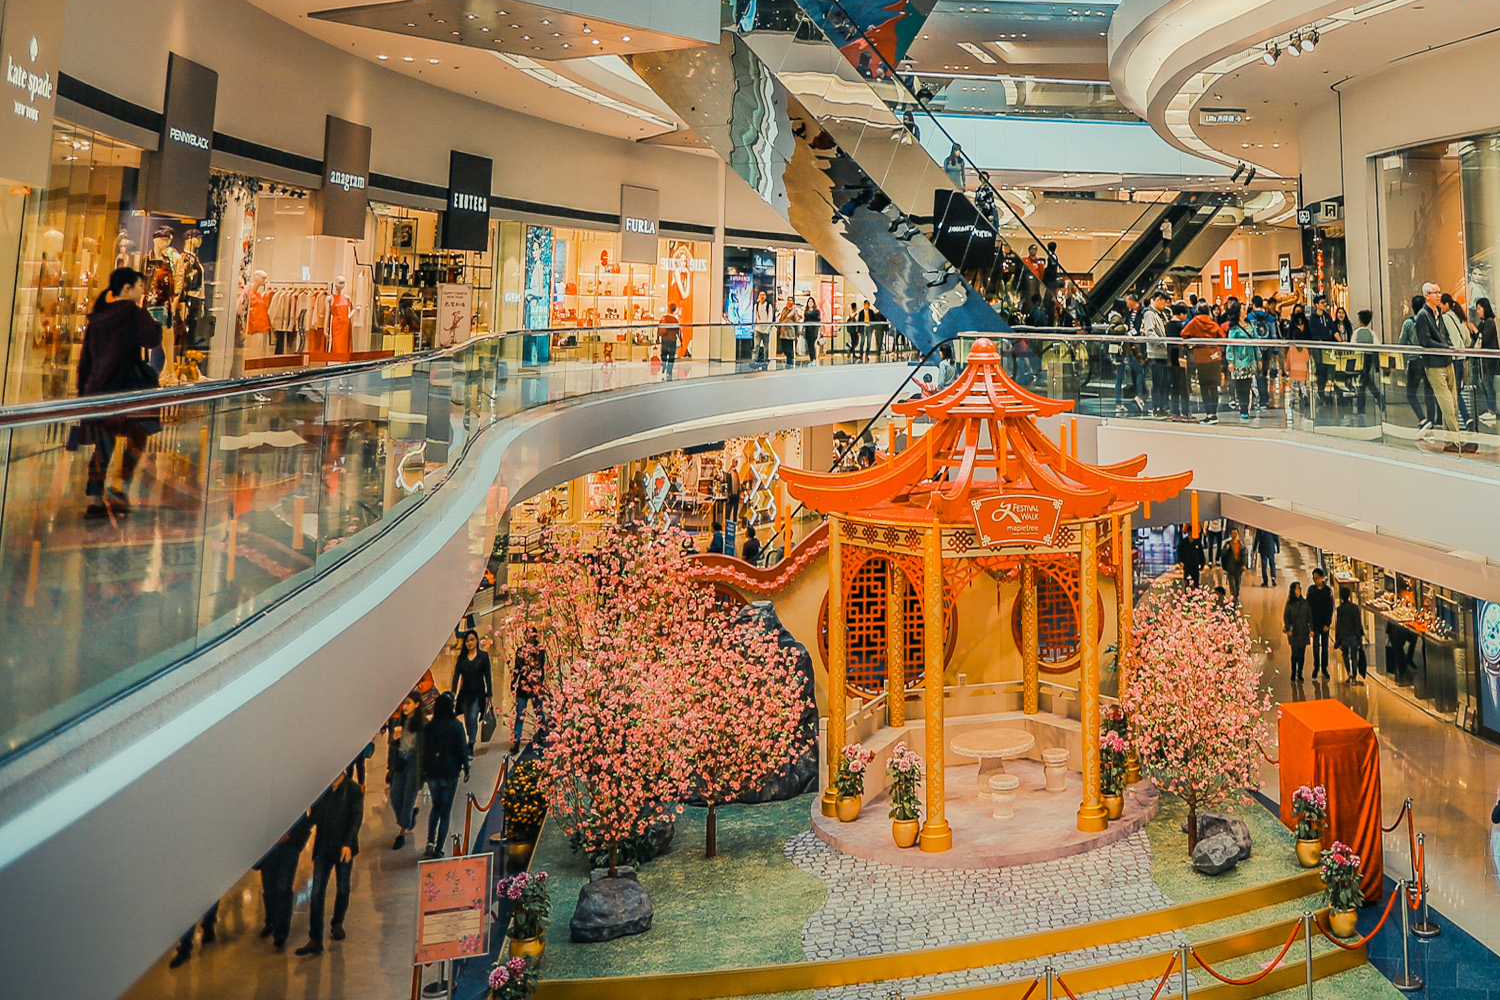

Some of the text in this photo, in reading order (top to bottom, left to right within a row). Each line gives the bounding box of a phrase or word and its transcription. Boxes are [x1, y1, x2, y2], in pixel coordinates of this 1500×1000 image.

[7, 53, 53, 102] kate spade
[14, 100, 40, 122] NEW YORK
[170, 127, 209, 150] PENNYBLACK
[330, 171, 365, 191] anagram
[453, 192, 487, 212] ENOTECA
[625, 217, 656, 234] FURLA
